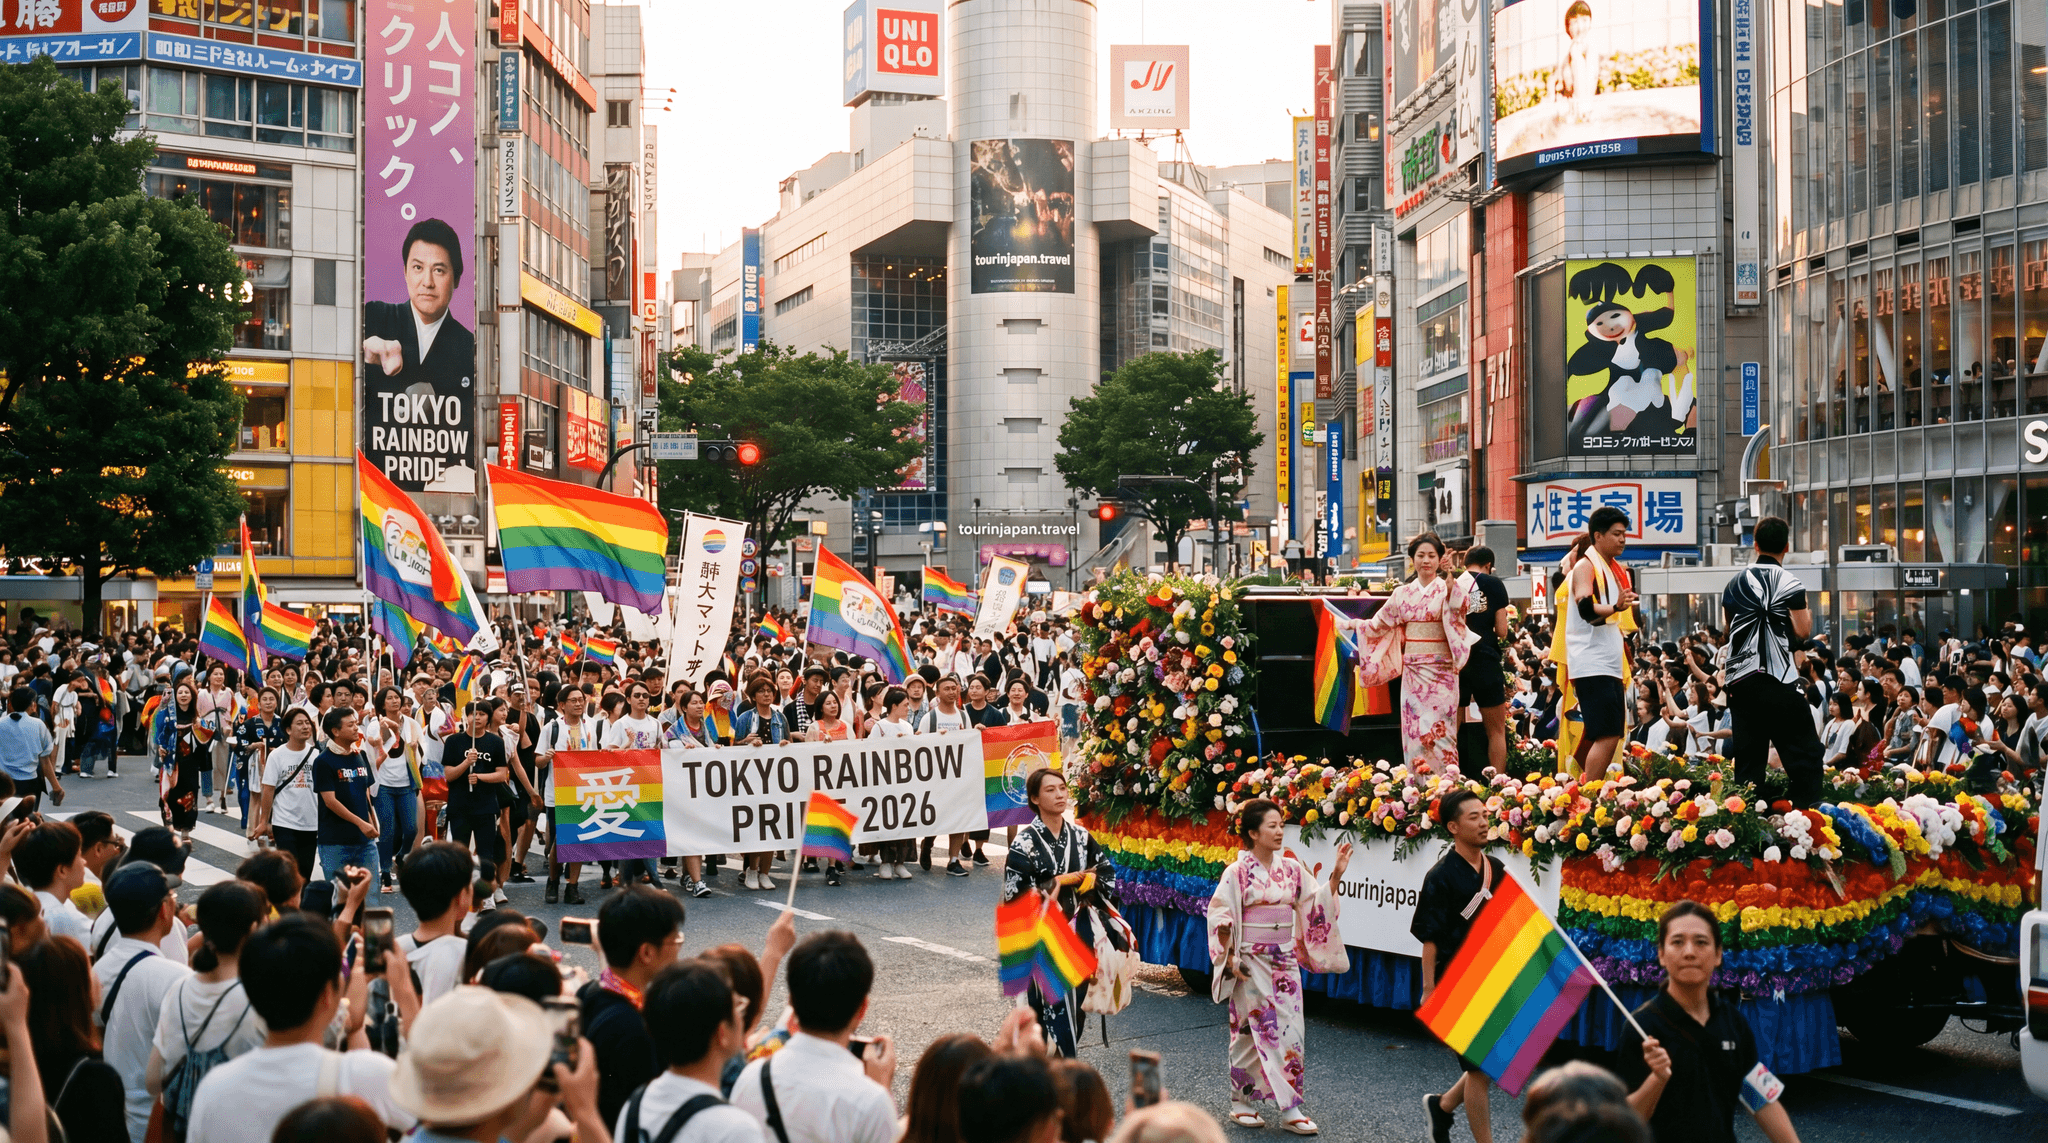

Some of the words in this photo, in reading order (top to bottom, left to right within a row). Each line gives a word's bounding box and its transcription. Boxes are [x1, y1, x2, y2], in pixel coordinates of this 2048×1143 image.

[883, 17, 928, 42] UNI
[883, 43, 933, 69] QLO
[379, 14, 417, 220] クリック。
[975, 252, 1070, 267] tourinjapan.travel
[377, 392, 461, 426] TOKYO
[372, 426, 469, 455] RAINBOW
[384, 455, 447, 482] PRIDE
[958, 522, 1080, 538] tourinjapan.travel
[682, 756, 799, 799] TOKYO
[813, 743, 964, 791] RAINBOW
[575, 767, 646, 842] 愛
[732, 797, 847, 843] PRI
[861, 790, 936, 833] 2026
[1329, 871, 1423, 911] ourinjapa
